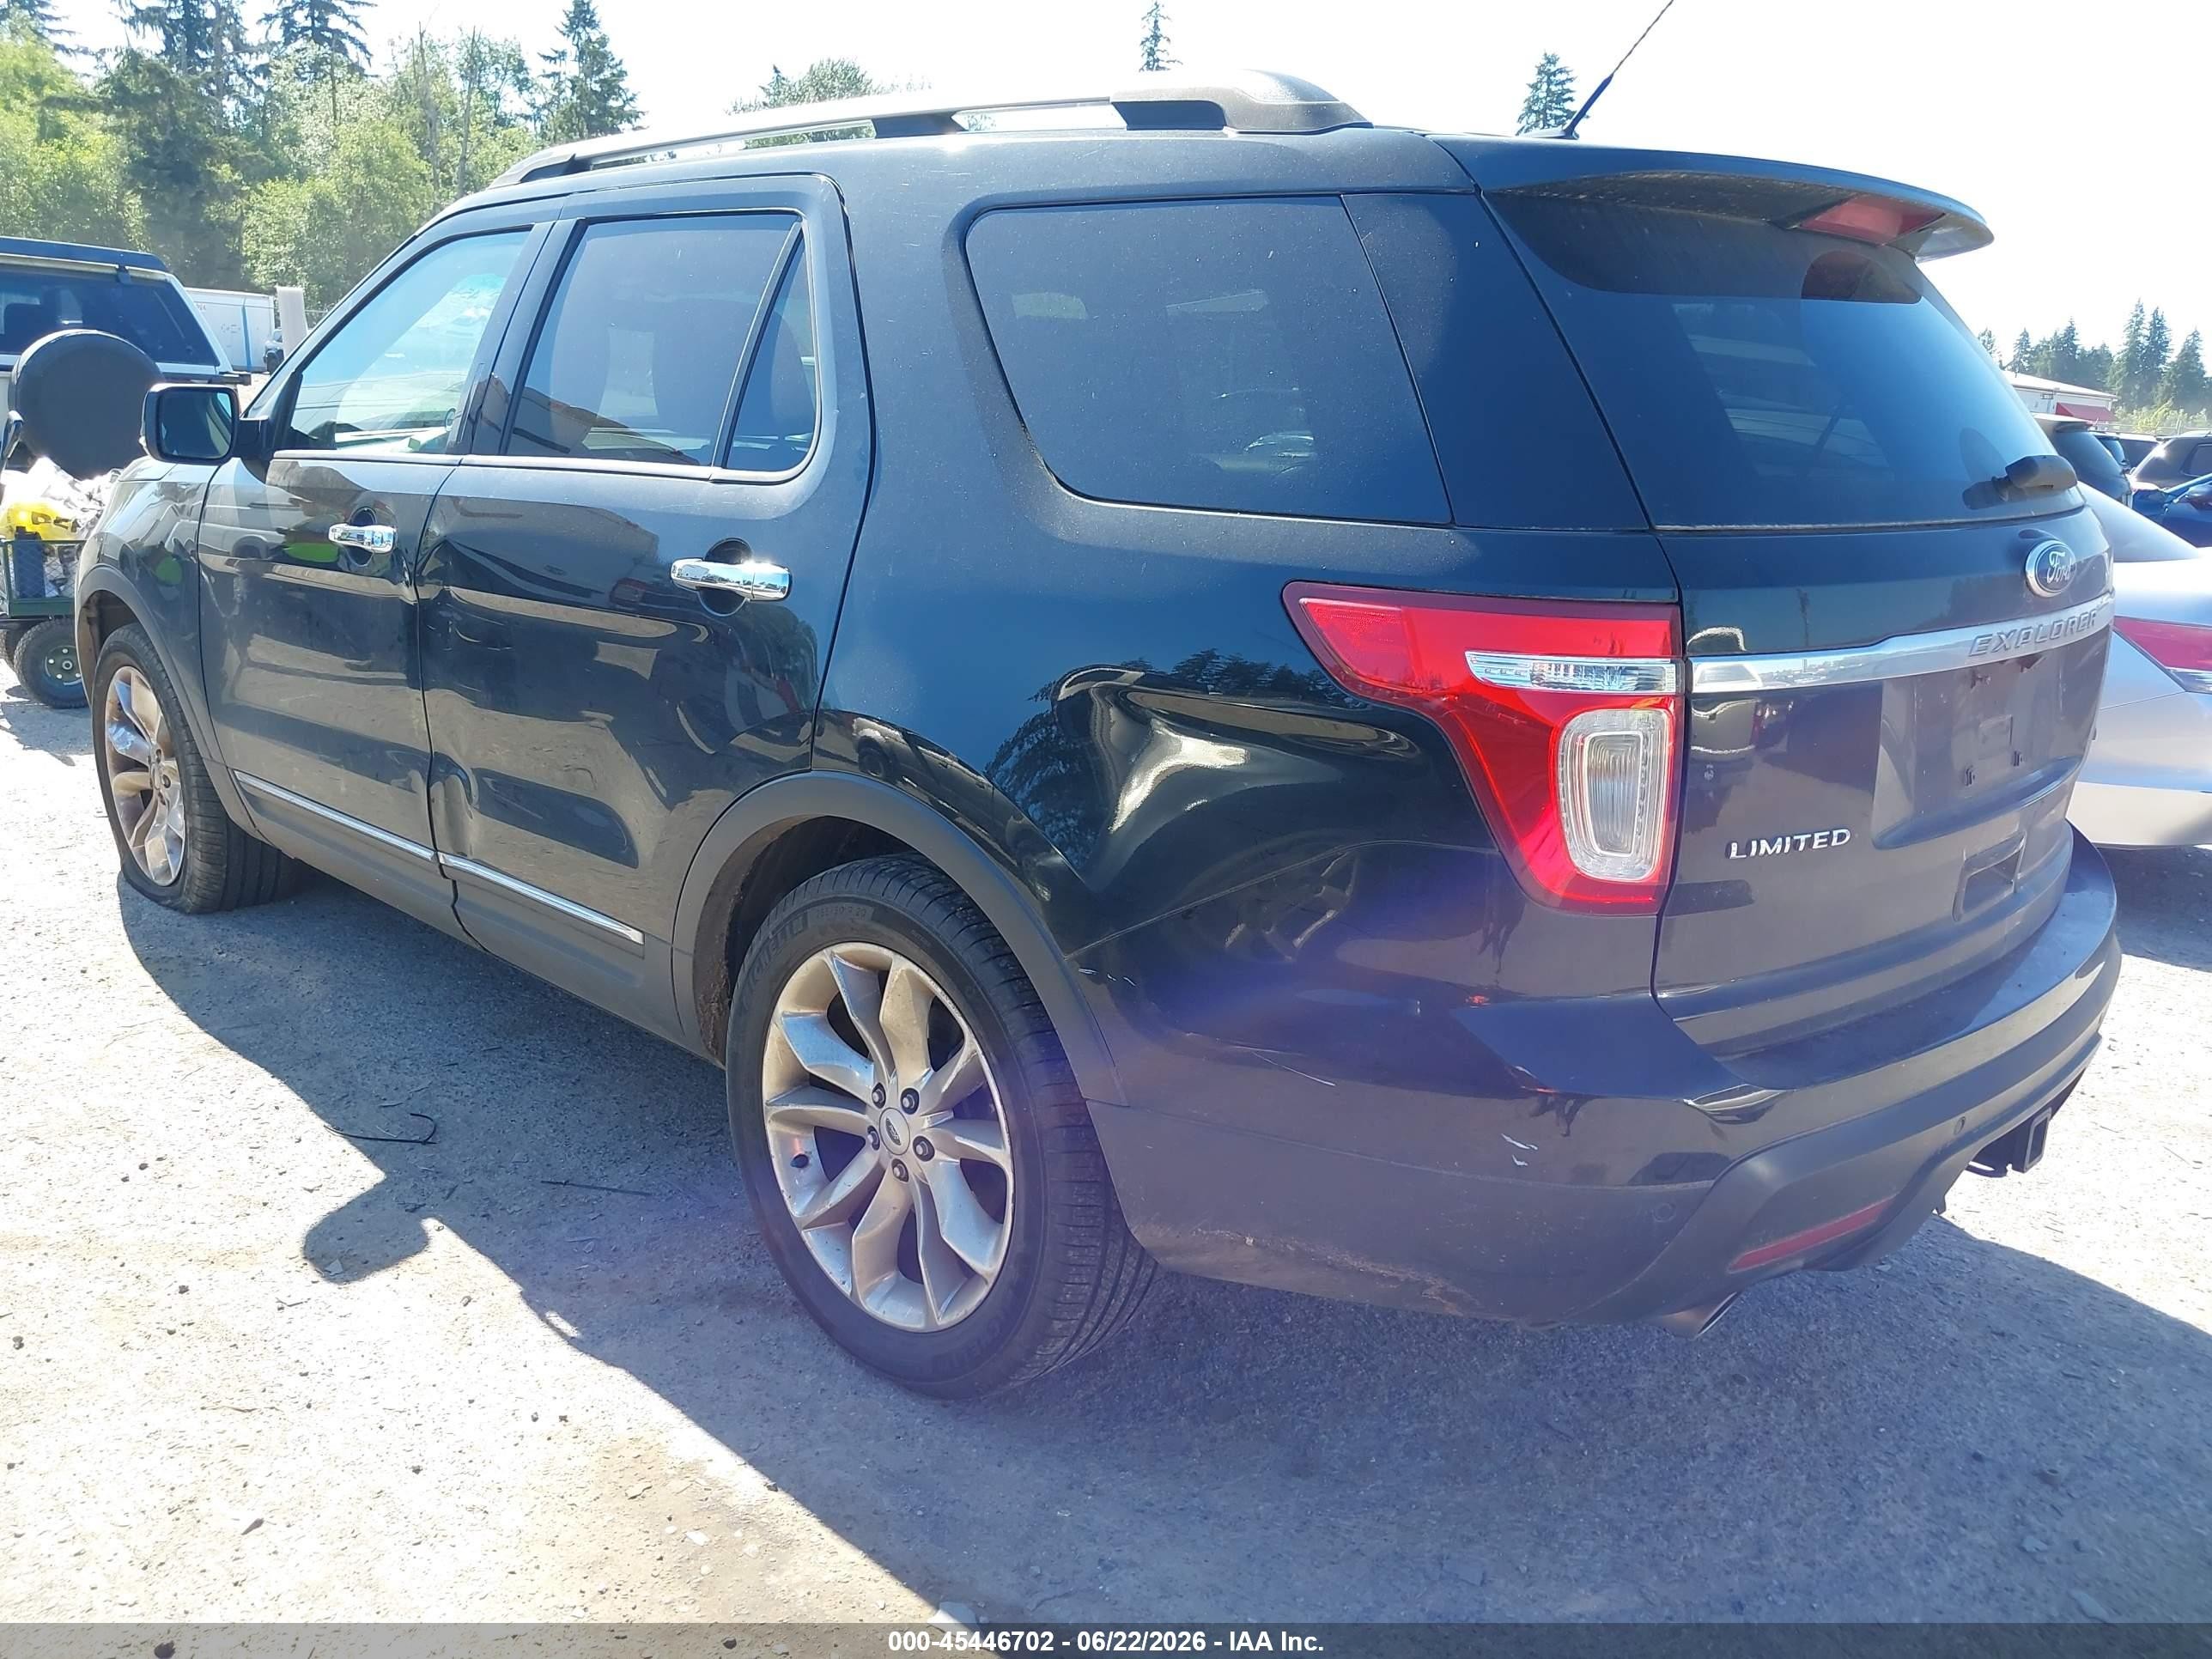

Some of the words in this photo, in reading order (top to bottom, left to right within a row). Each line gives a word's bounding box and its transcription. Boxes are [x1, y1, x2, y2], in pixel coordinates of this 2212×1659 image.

[2046, 550, 2074, 584] Ford
[1969, 609, 2098, 657] EXPLORER
[1729, 828, 1851, 860] LIMITED
